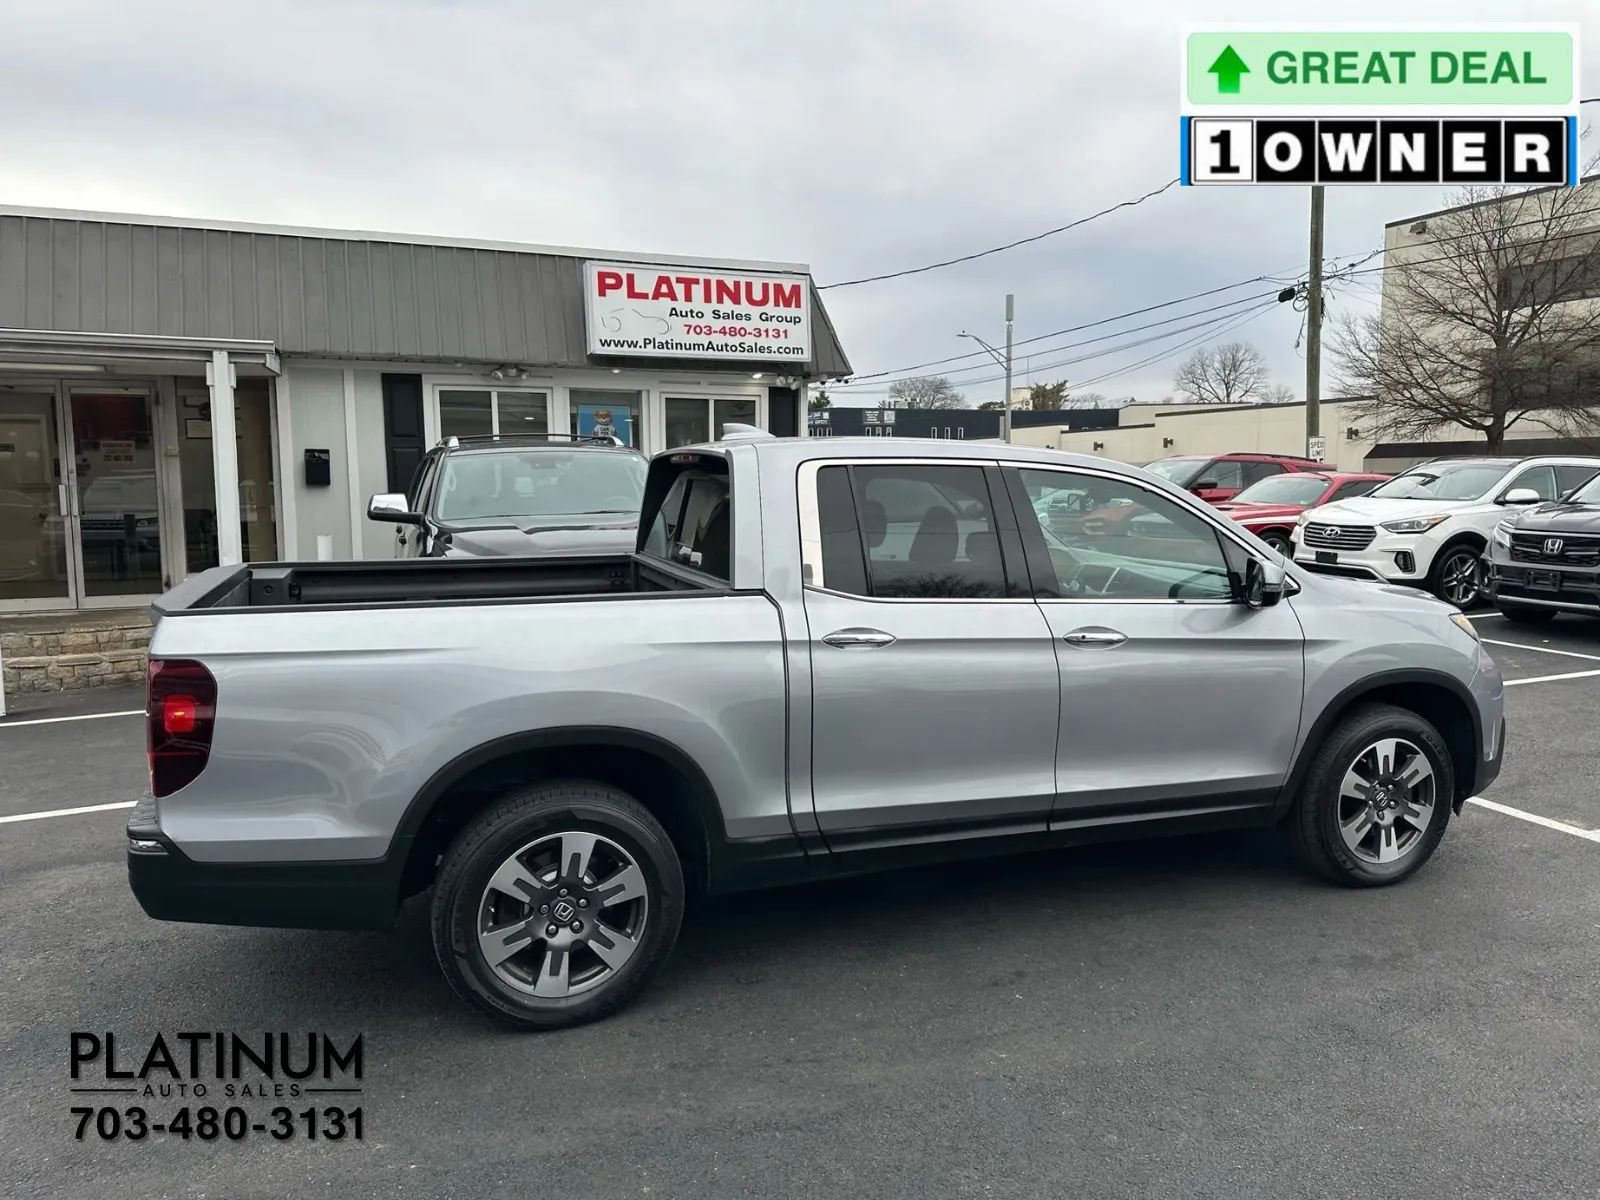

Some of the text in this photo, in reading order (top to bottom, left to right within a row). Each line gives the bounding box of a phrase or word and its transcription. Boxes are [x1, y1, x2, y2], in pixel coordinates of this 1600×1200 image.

[597, 271, 801, 308] PLATINUM
[669, 307, 802, 325] Auto Sales Group
[684, 324, 788, 339] 703-480-3131
[599, 337, 804, 355] www.PlatinumAutoSales.com
